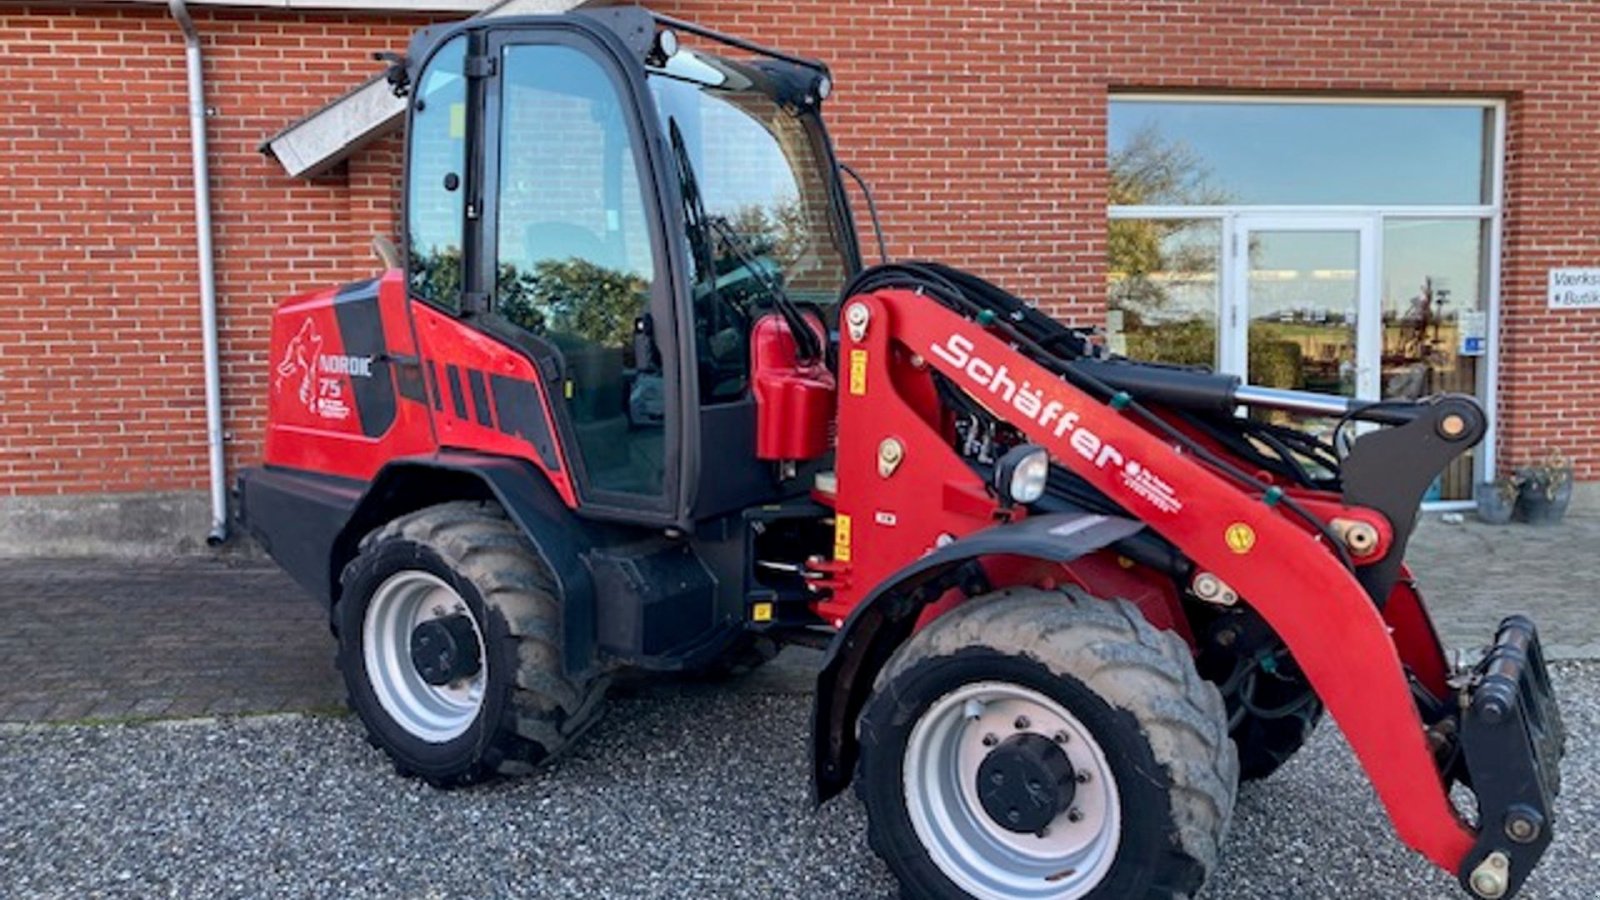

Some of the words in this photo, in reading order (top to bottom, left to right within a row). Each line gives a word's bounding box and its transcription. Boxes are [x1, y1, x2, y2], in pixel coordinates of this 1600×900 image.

[1555, 272, 1600, 286] Værks
[320, 355, 372, 376] NORDIC
[320, 379, 341, 397] 75
[931, 334, 1122, 468] Schäffer
